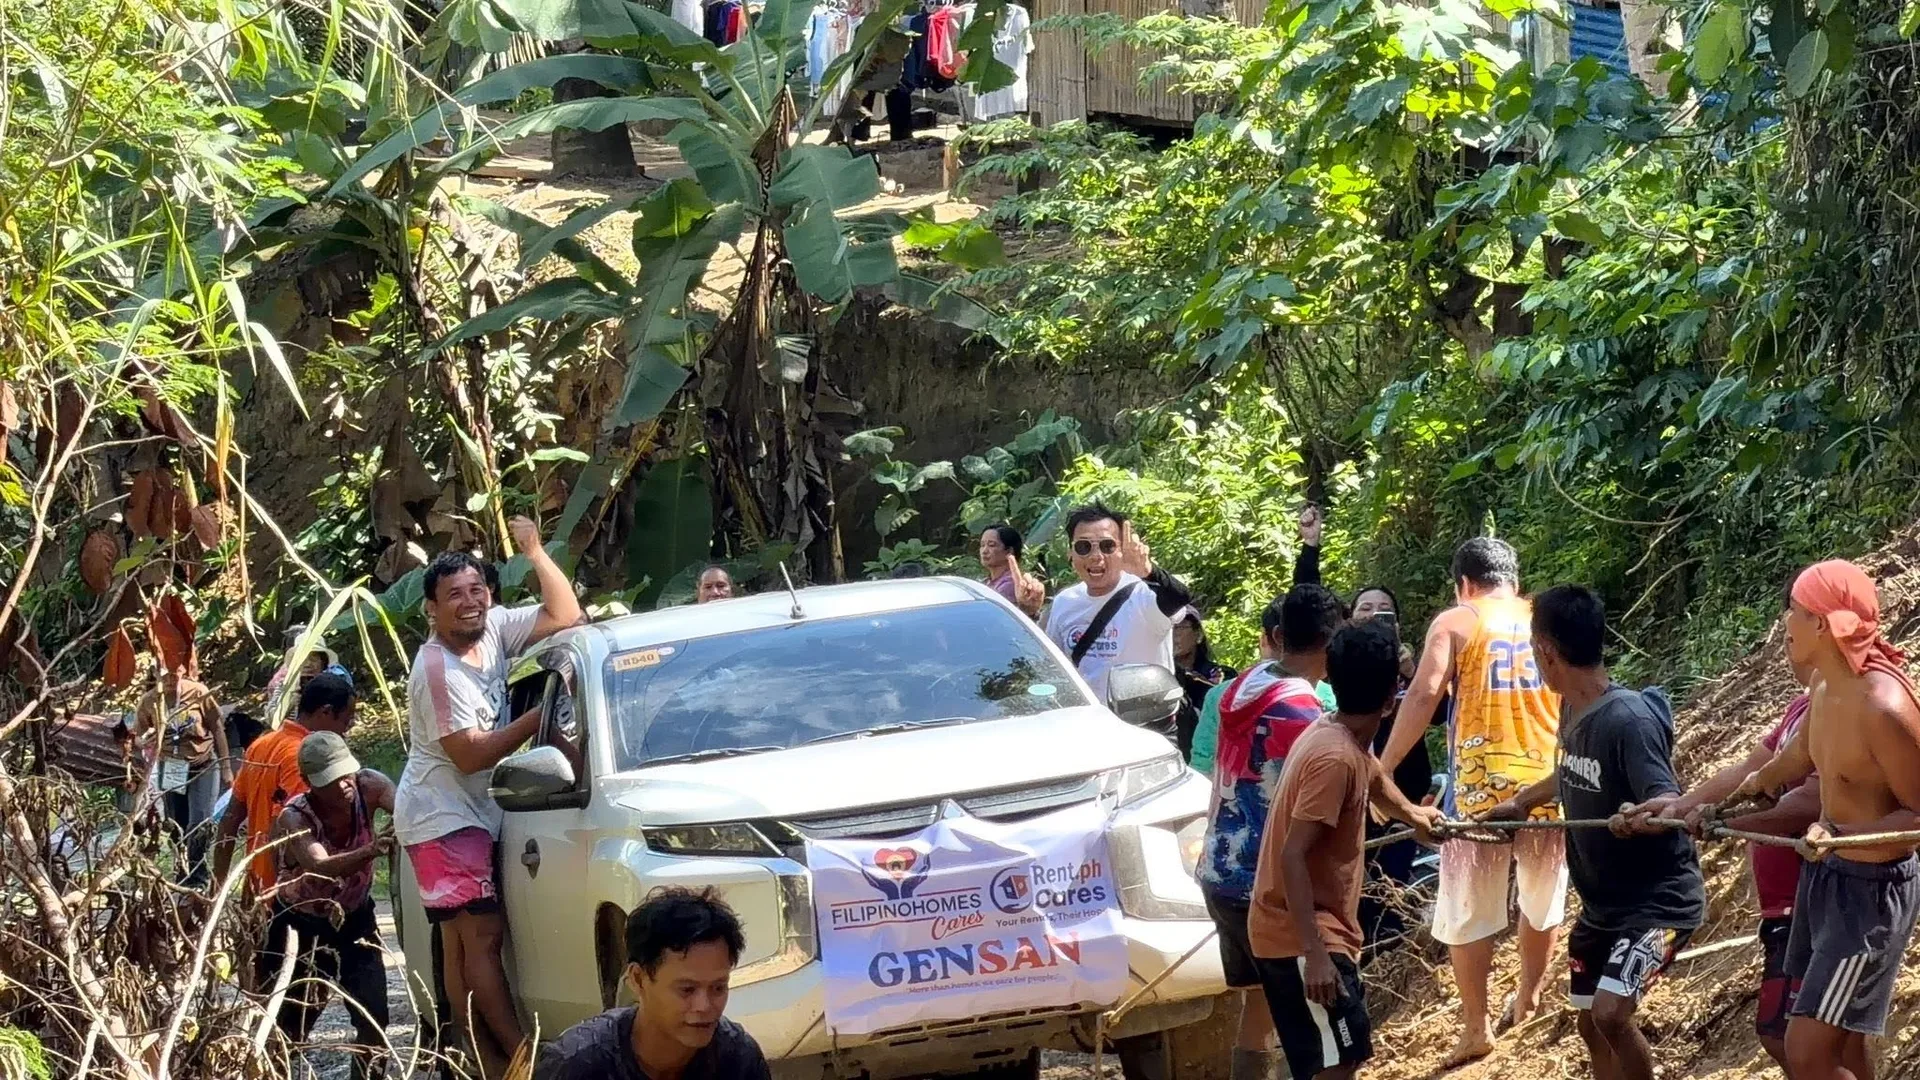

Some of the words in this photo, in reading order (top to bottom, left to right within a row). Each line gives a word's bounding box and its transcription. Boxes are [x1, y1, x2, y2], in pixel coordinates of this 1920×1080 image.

[1489, 640, 1543, 690] 23
[1031, 858, 1102, 886] Rent.ph
[831, 893, 982, 925] FILIPINOHOMES
[1035, 885, 1107, 909] Cares
[931, 909, 985, 940] Cares
[995, 916, 1018, 928] Your
[1058, 908, 1081, 920] Their
[868, 931, 1081, 988] GENSAN
